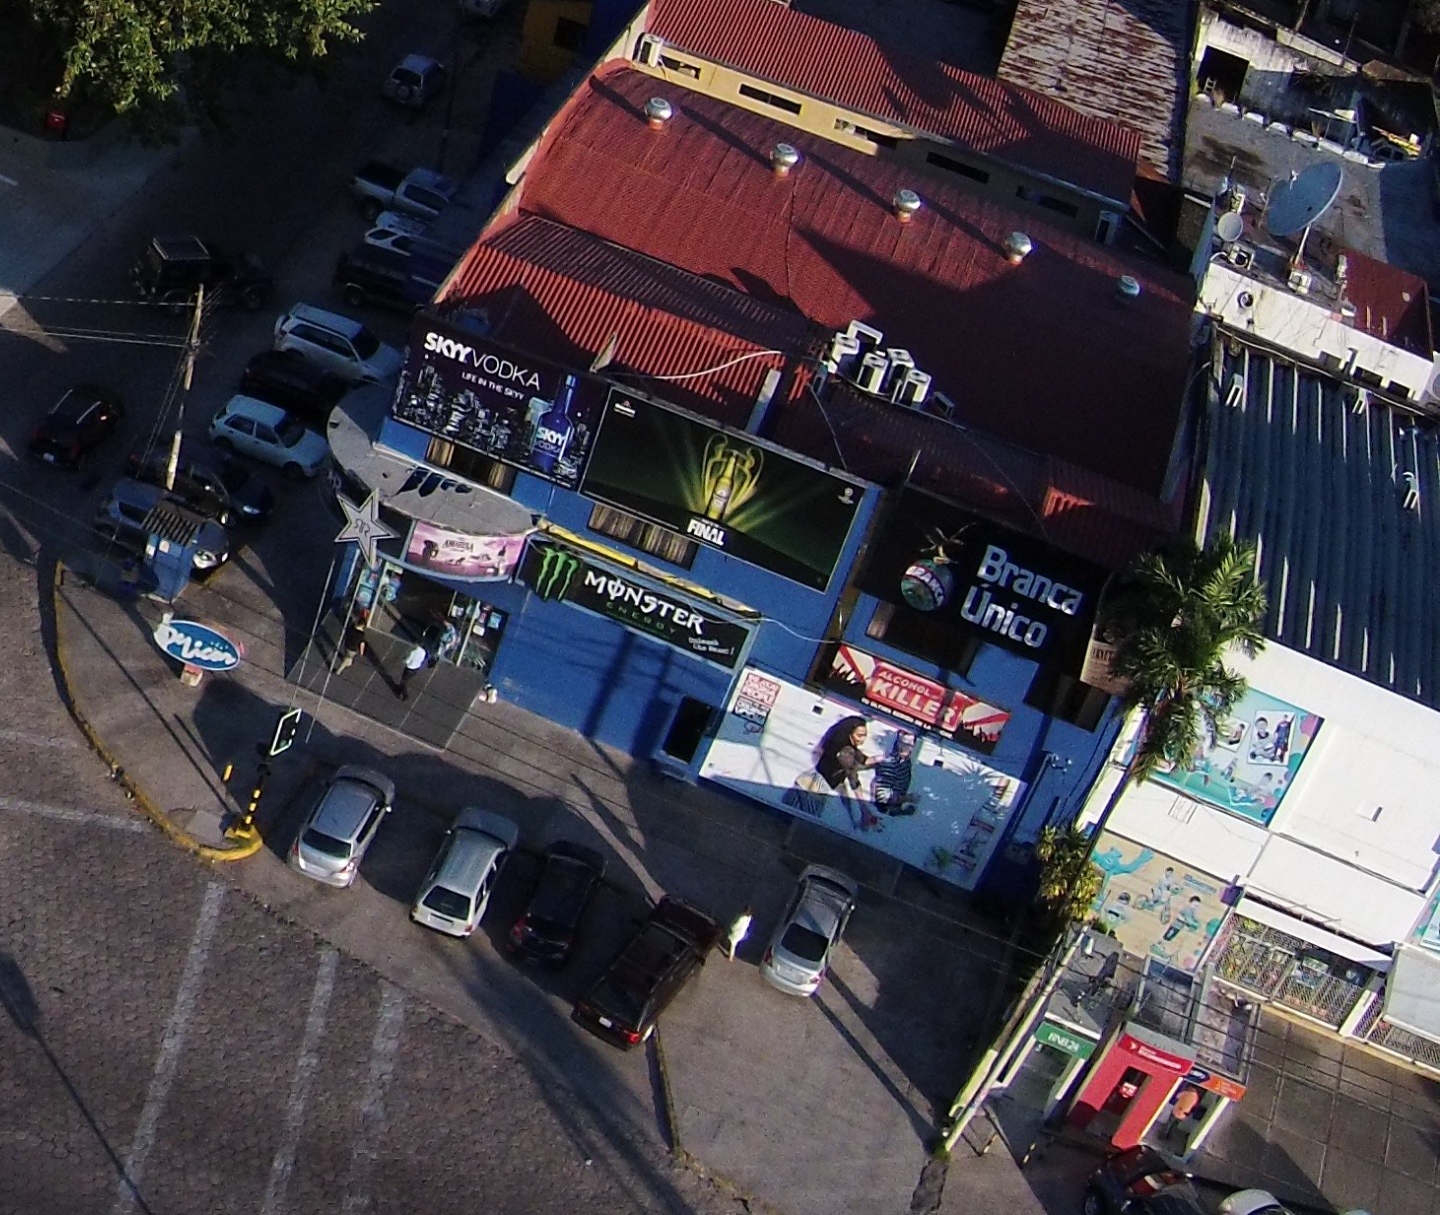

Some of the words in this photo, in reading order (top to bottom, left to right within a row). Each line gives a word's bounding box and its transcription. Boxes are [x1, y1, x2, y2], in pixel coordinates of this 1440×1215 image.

[424, 332, 472, 363] SKYY
[471, 349, 540, 391] VODKA
[687, 519, 724, 546] FINAL
[584, 571, 705, 634] MONSTER
[977, 544, 1084, 615] Branca
[960, 583, 1048, 648] Único
[873, 680, 956, 724] KILLER
[880, 671, 931, 696] ALCOHOL
